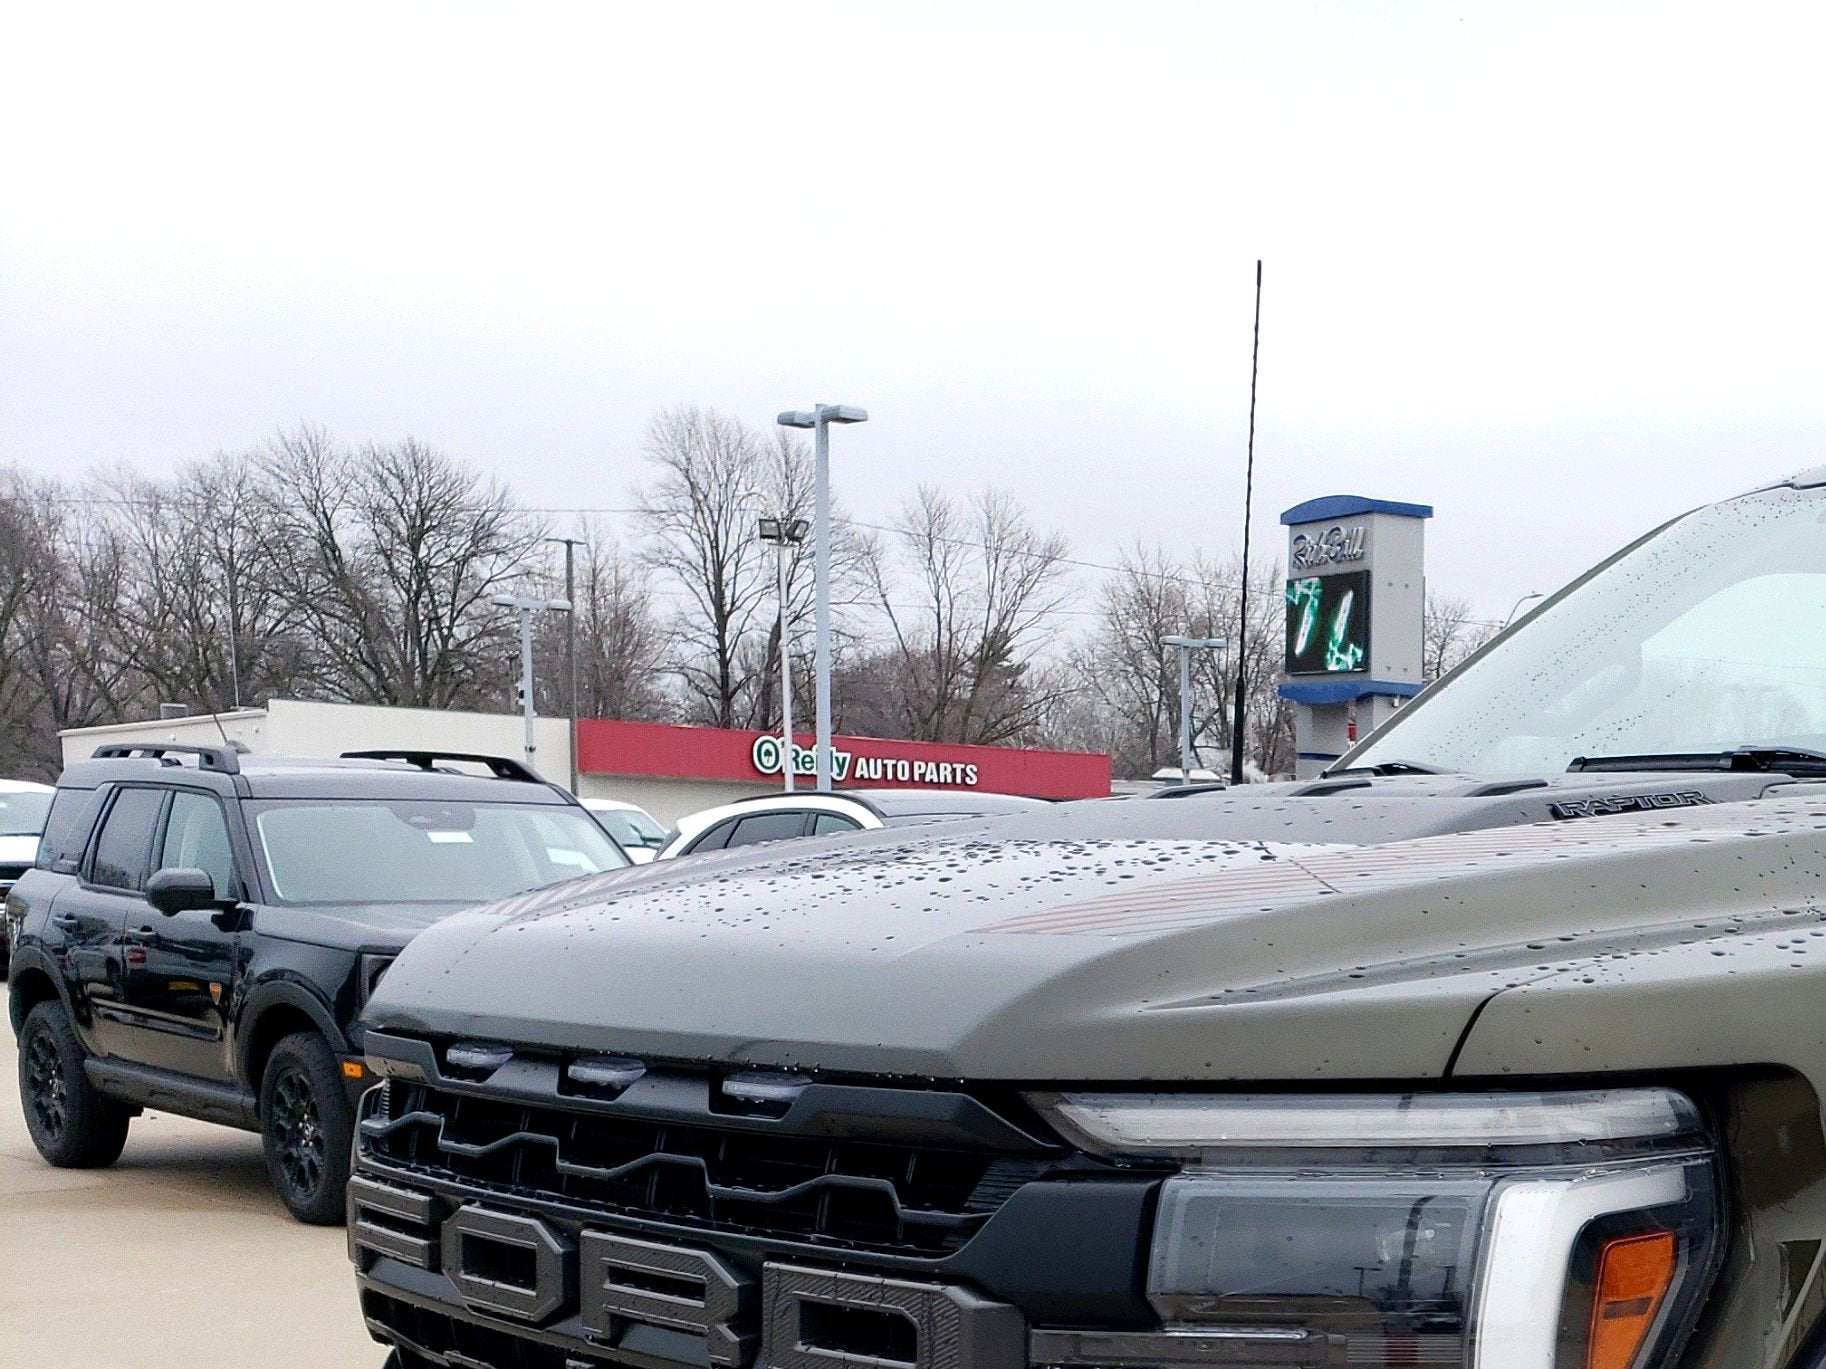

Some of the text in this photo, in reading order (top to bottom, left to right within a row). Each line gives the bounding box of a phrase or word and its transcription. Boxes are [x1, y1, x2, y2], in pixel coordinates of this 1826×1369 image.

[855, 757, 910, 781] AUTO
[914, 760, 978, 786] PARTS
[1551, 790, 1712, 821] RAPTOR
